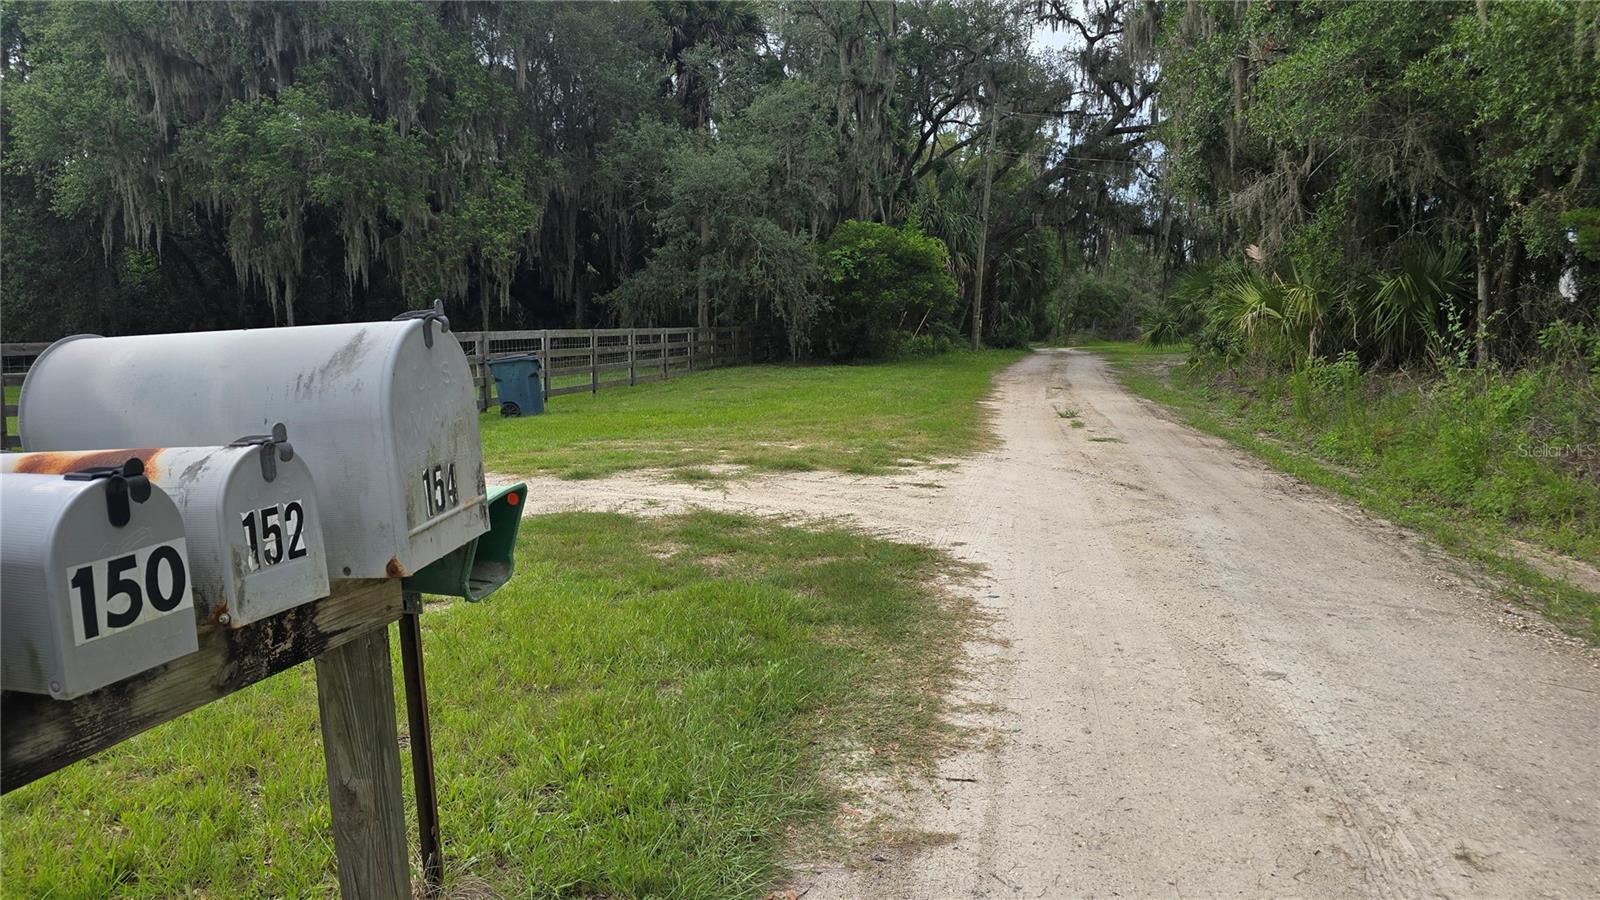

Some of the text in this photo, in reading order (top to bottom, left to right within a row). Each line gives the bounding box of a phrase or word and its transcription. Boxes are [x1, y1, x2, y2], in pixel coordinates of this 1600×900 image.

[422, 463, 459, 517] 154
[242, 501, 307, 569] 152
[71, 545, 186, 640] 150
